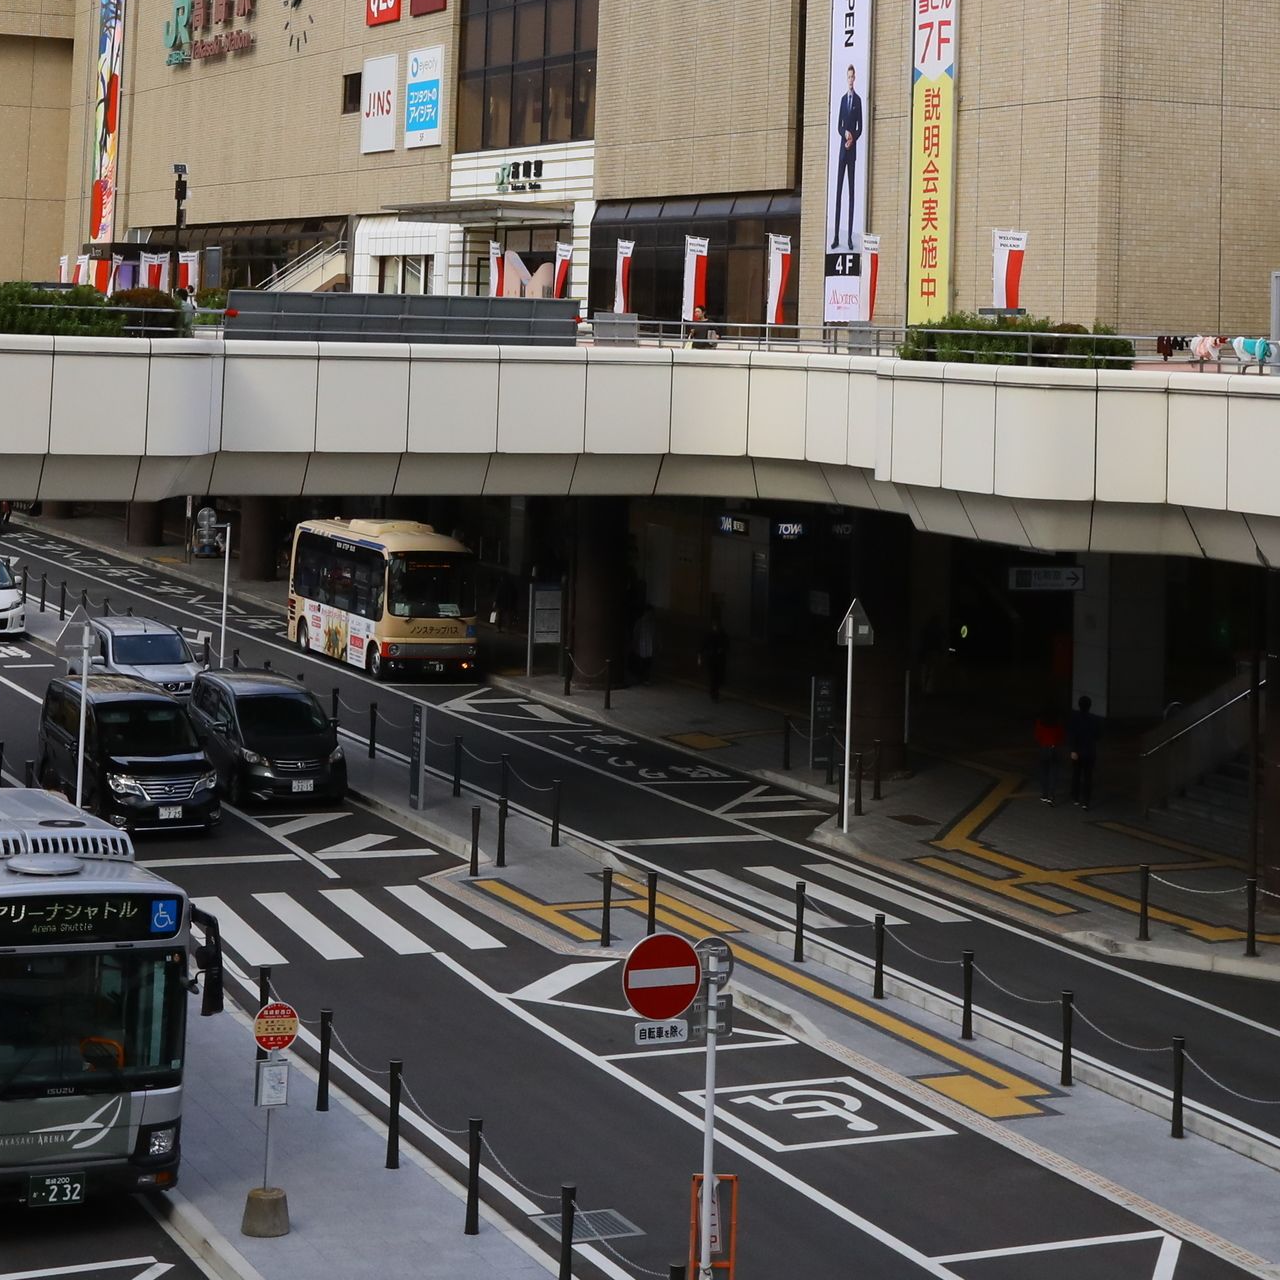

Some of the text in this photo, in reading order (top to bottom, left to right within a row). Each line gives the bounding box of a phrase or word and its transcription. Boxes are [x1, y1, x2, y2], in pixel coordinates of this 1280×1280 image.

[917, 20, 952, 64] 7F
[408, 105, 437, 124] アイシティ
[920, 86, 942, 308] 説明会実施中
[835, 254, 854, 275] 4F
[778, 523, 803, 535] TOWA
[410, 626, 460, 635] ノンステップバス
[31, 922, 94, 934] Arena Shuttle
[639, 1024, 685, 1041] 自転車を除く
[46, 1086, 75, 1095] ISUZU
[37, 1133, 65, 1147] ARENA
